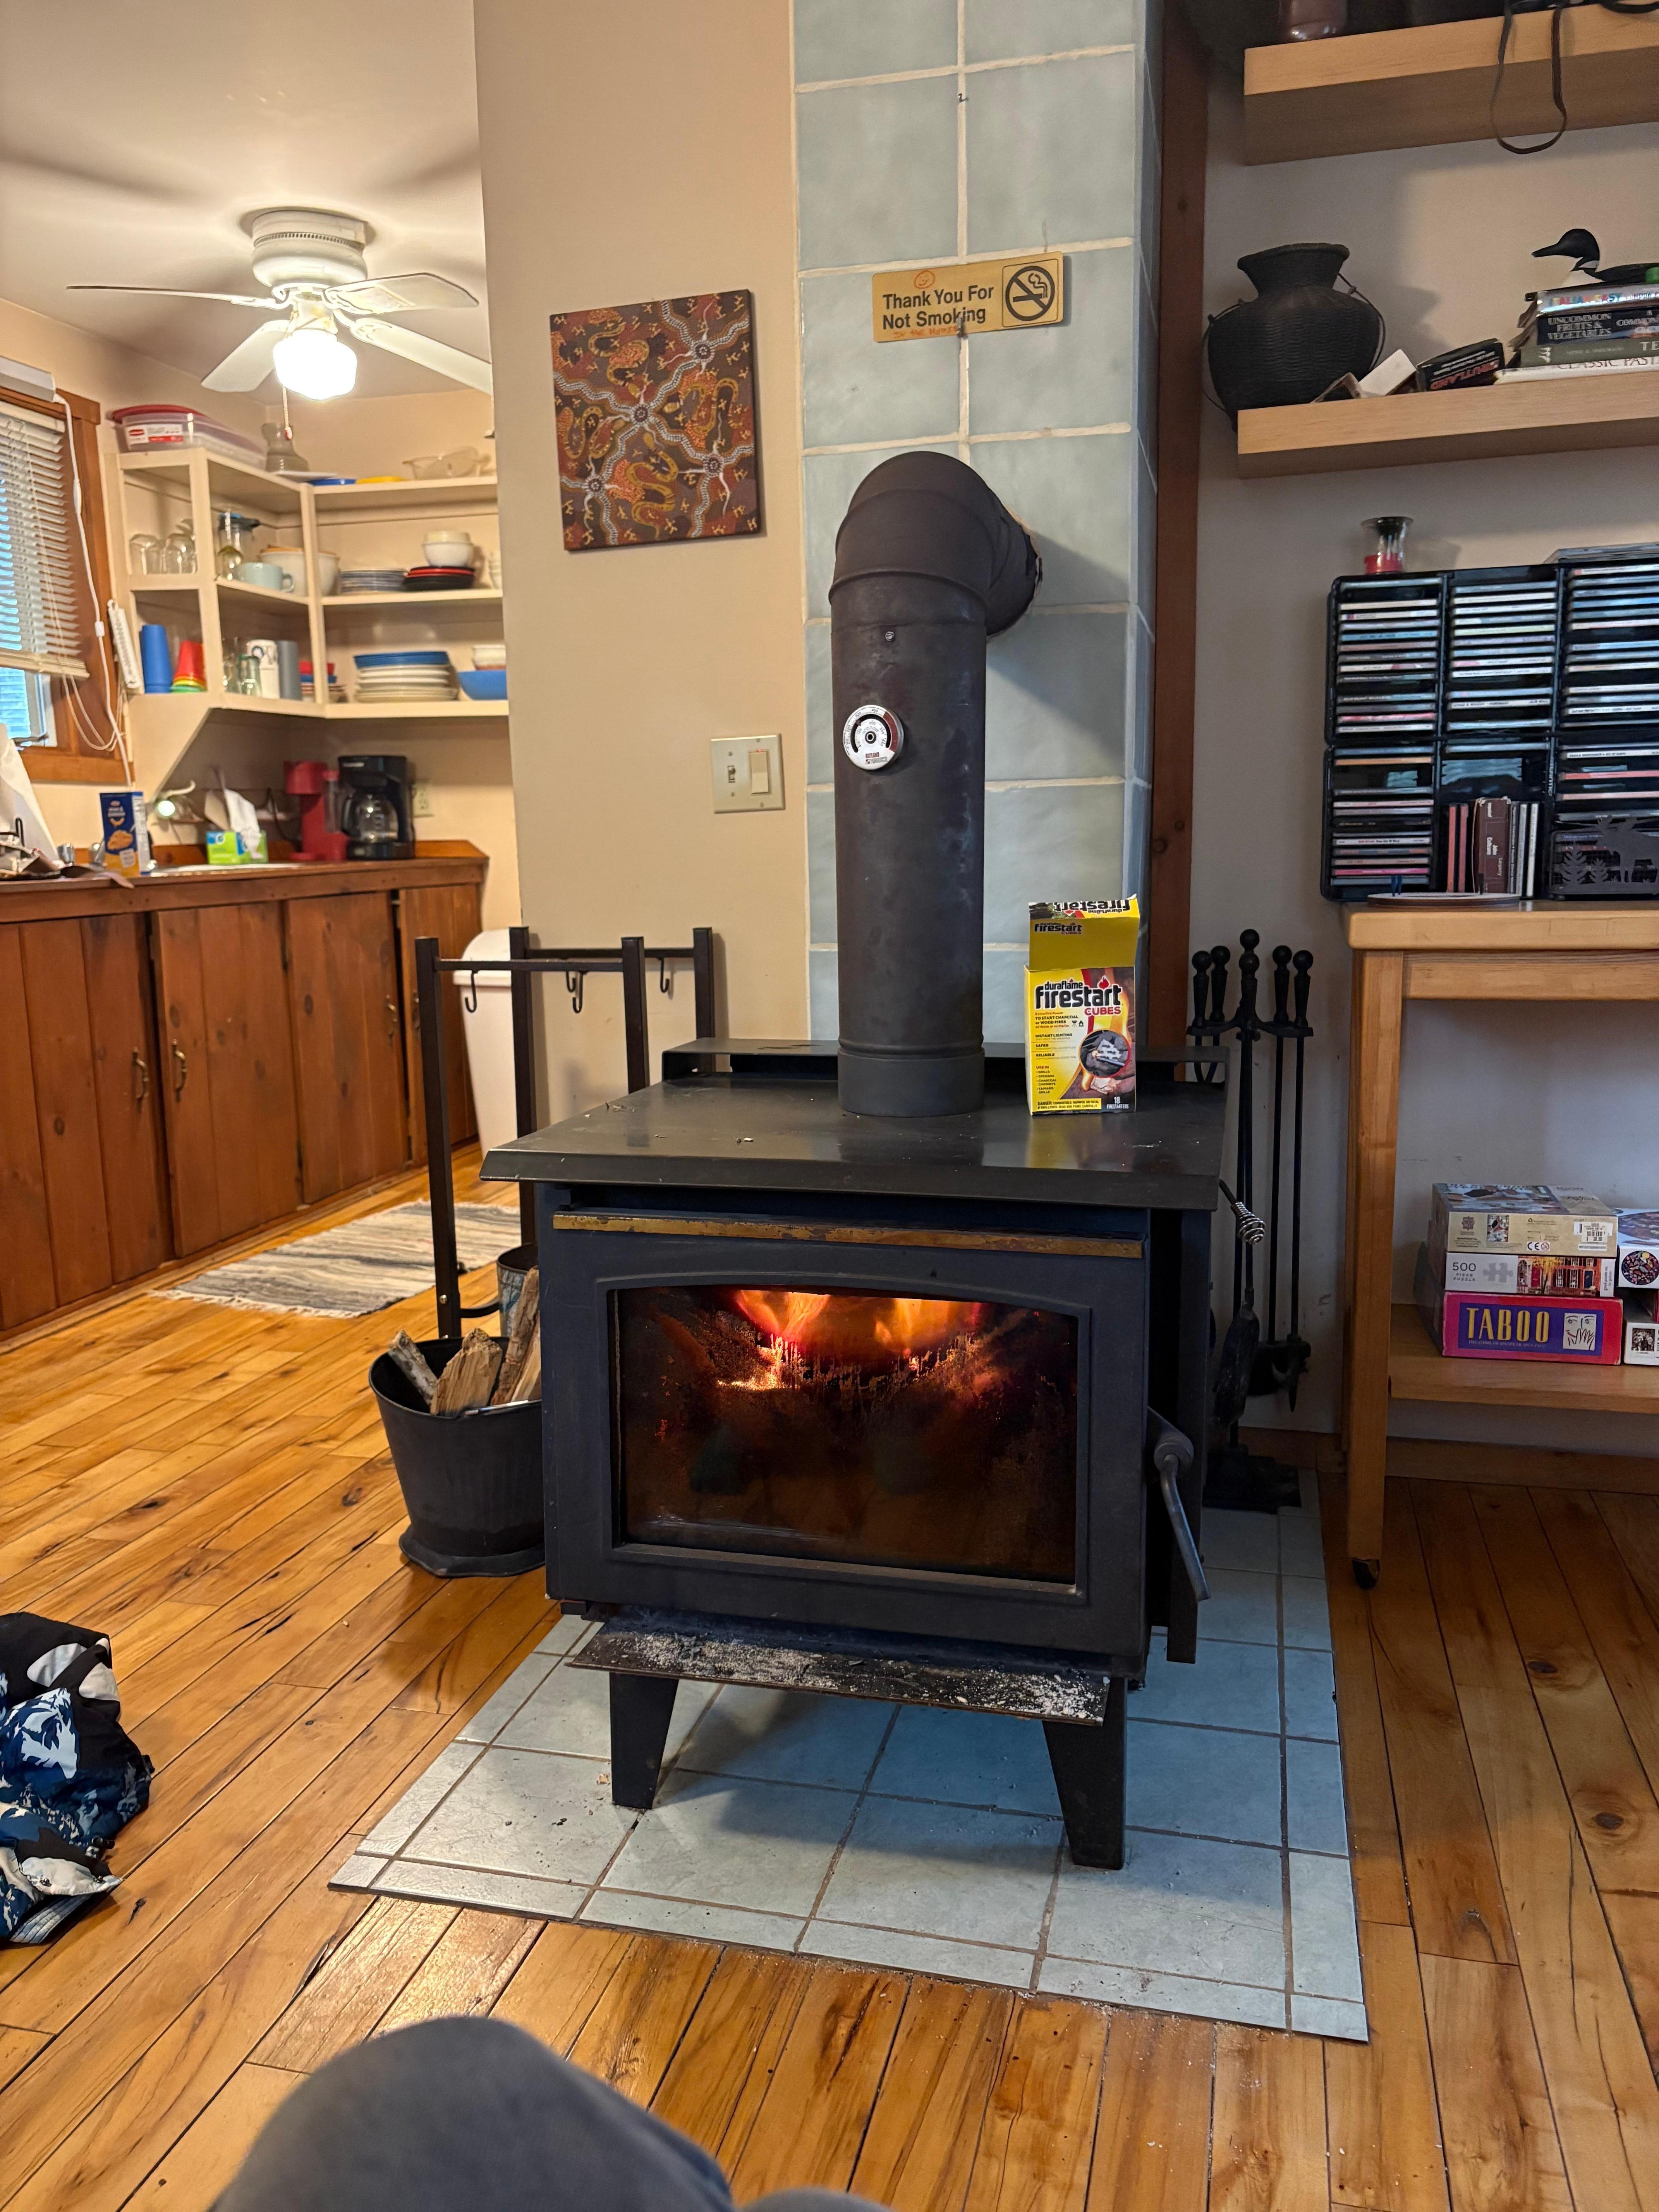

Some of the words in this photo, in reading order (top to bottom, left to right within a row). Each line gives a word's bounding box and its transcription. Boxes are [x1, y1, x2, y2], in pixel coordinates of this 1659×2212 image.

[883, 291, 931, 309] Thank
[934, 289, 963, 304] You
[968, 285, 994, 301] For
[883, 314, 910, 330] Not
[917, 306, 986, 327] Smoking
[1548, 313, 1613, 325] UNCOMMON
[1557, 322, 1592, 332] FRUITS
[1547, 328, 1611, 340] VEGETABLES
[1054, 899, 1130, 911] firestart
[1034, 924, 1082, 932] firestart
[1045, 981, 1083, 990] duraflame
[1036, 985, 1121, 1009] firestart
[1084, 1007, 1121, 1015] CUBES
[1453, 1262, 1476, 1271] 500
[1466, 1307, 1550, 1343] TABOO
